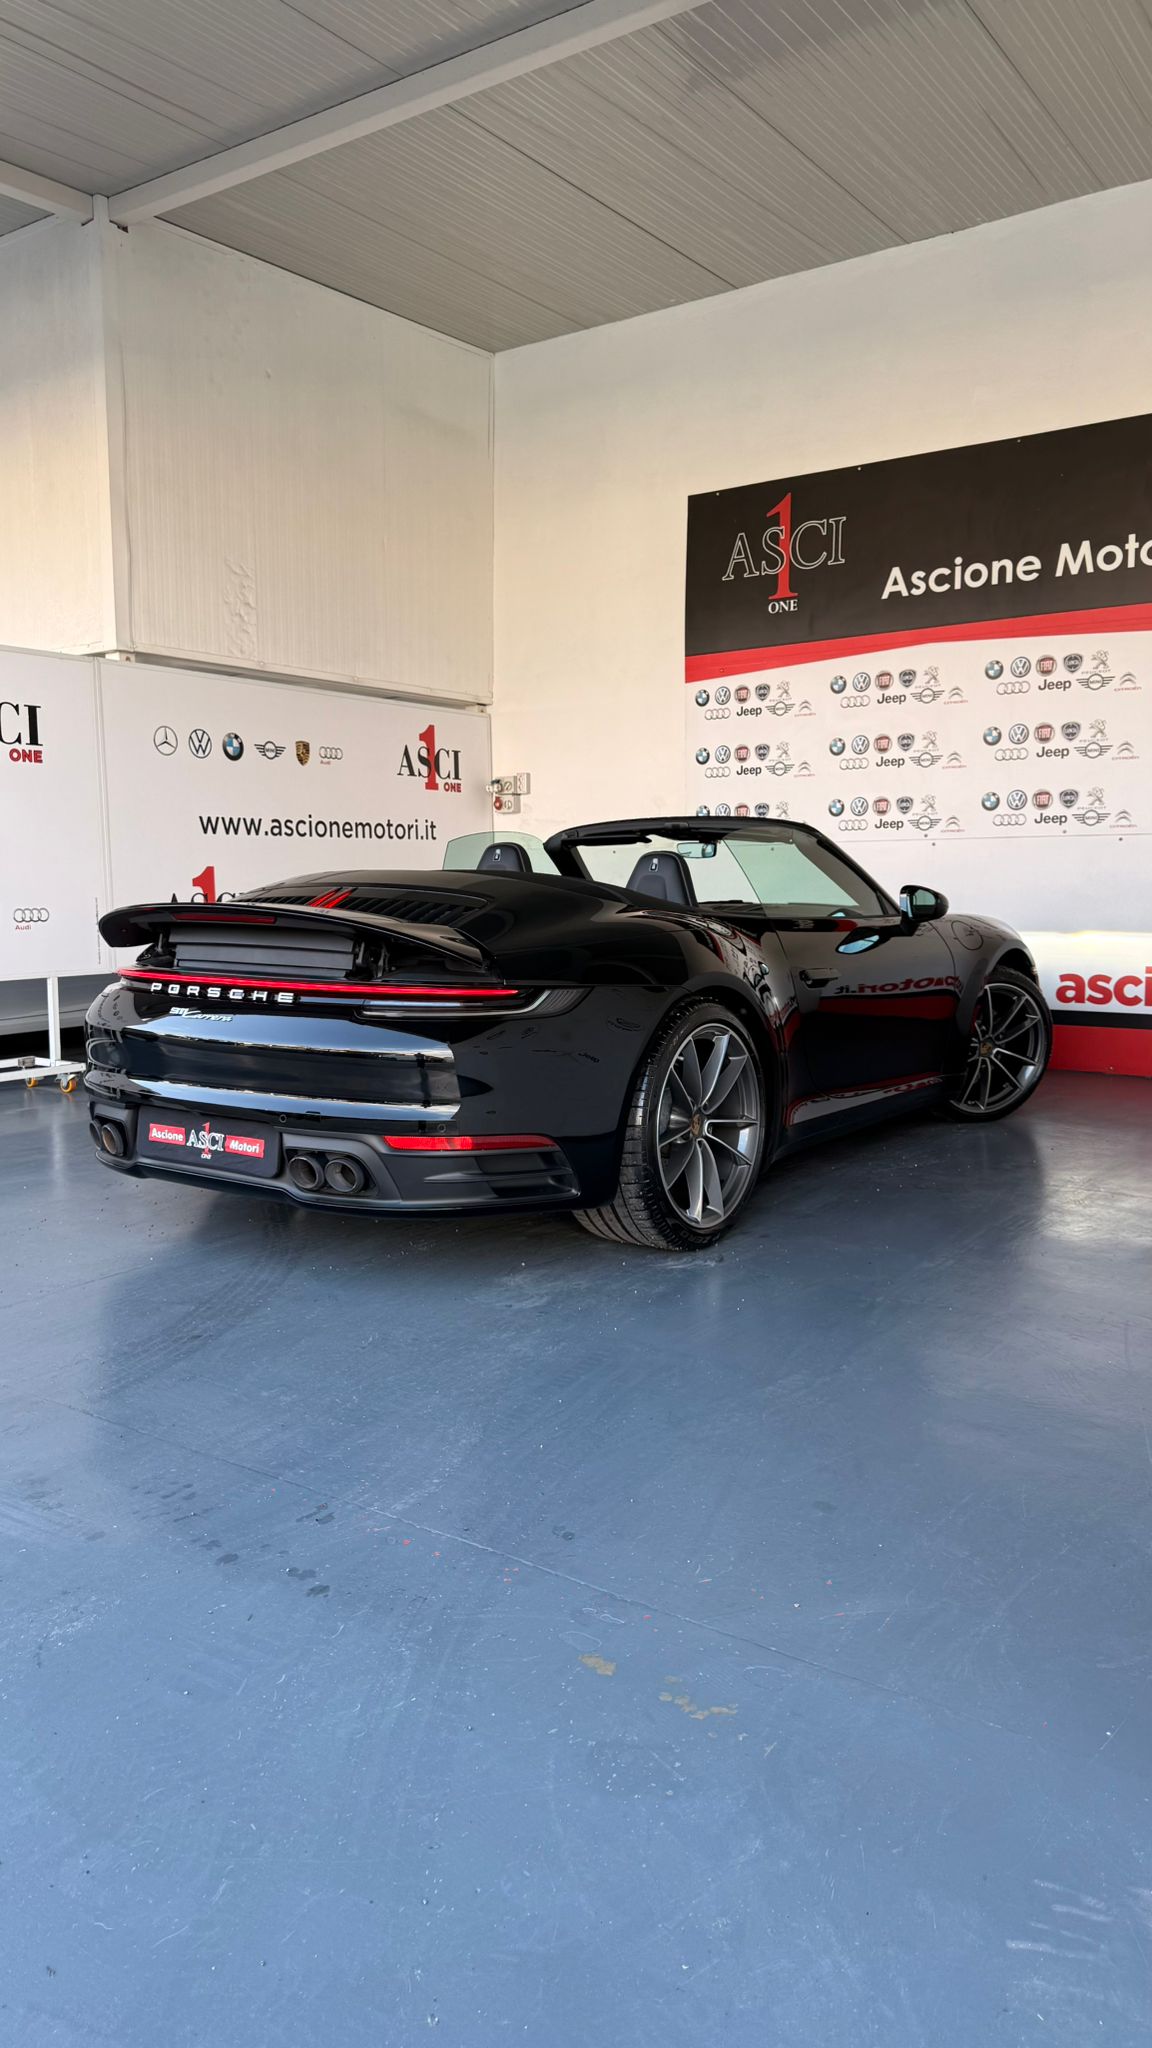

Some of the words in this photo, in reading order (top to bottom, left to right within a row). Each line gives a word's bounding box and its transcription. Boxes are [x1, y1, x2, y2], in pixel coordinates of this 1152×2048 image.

[722, 516, 847, 581] ASCI
[881, 555, 1042, 600] Ascione
[768, 599, 798, 614] ONE
[1038, 679, 1071, 691] Jeep
[877, 693, 906, 705] Jeep
[736, 706, 762, 717] Jeep
[9, 748, 43, 763] ONE
[1036, 746, 1070, 759] Jeep
[397, 744, 462, 780] ASCI
[875, 756, 905, 768] Jeep
[736, 765, 762, 776] Jeep
[443, 782, 462, 792] ONE
[874, 819, 904, 830] Jeep
[1034, 813, 1068, 825] Jeep
[199, 814, 437, 840] www.ascionemotori.it
[150, 982, 295, 1003] PORSCHE
[1056, 966, 1152, 1007] asci
[169, 1007, 190, 1015] 911
[182, 1010, 234, 1022] Carrera
[151, 1128, 184, 1142] Ascione
[186, 1129, 225, 1152] ASCI
[229, 1140, 260, 1153] Motori
